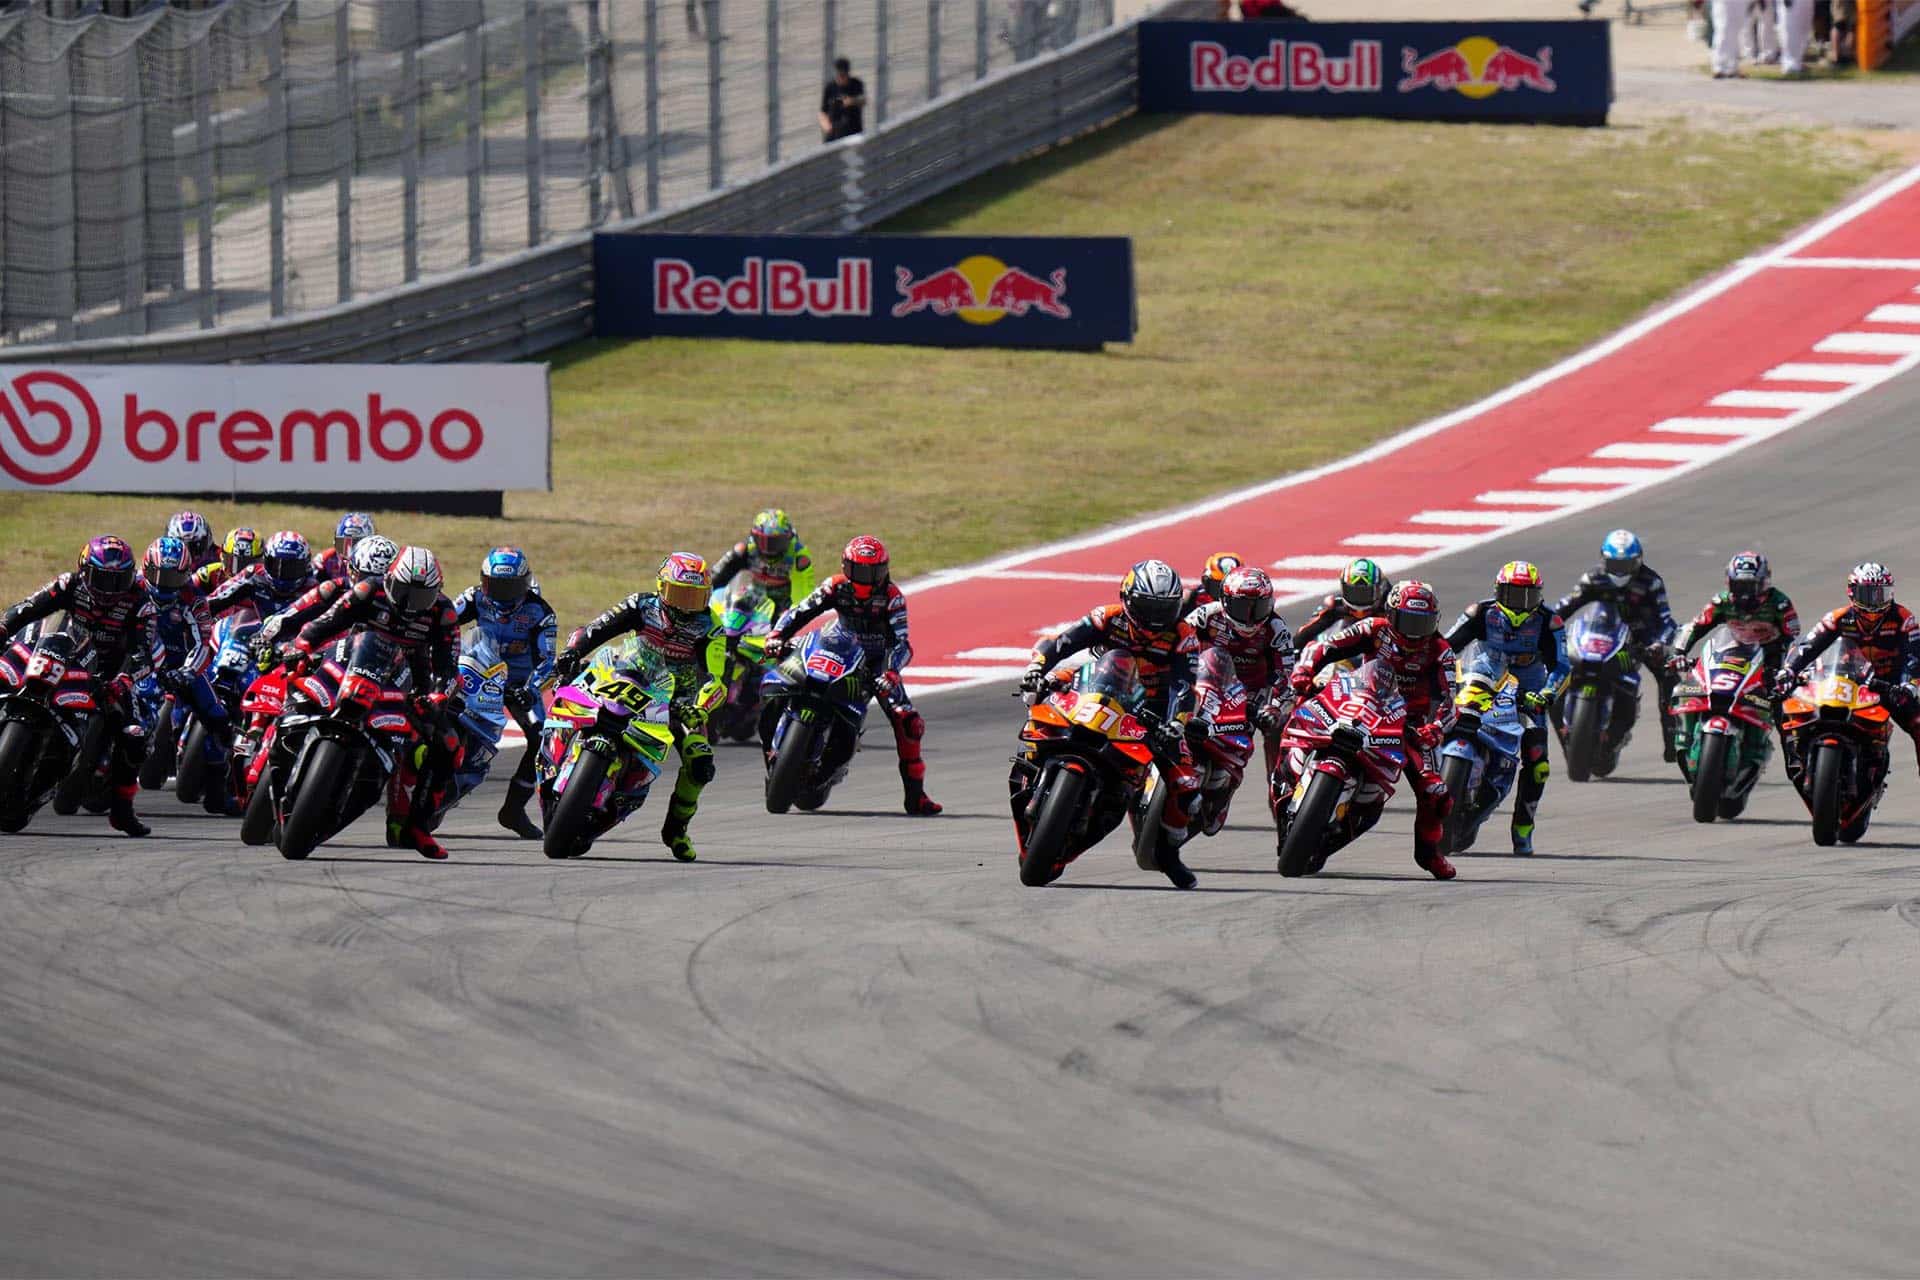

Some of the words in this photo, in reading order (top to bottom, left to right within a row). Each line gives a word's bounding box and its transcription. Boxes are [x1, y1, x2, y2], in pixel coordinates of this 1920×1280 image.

[1190, 40, 1286, 92] Red
[1291, 40, 1382, 93] Bull
[653, 257, 762, 314] Red
[766, 258, 872, 317] Bull
[124, 393, 484, 463] brembo
[807, 655, 846, 677] 20
[596, 680, 654, 714] 49
[1074, 702, 1121, 731] 37
[1311, 700, 1333, 725] Lenovo
[1338, 701, 1383, 730] 93
[1214, 723, 1245, 733] Lenovo
[1371, 736, 1401, 745] Lenovo
